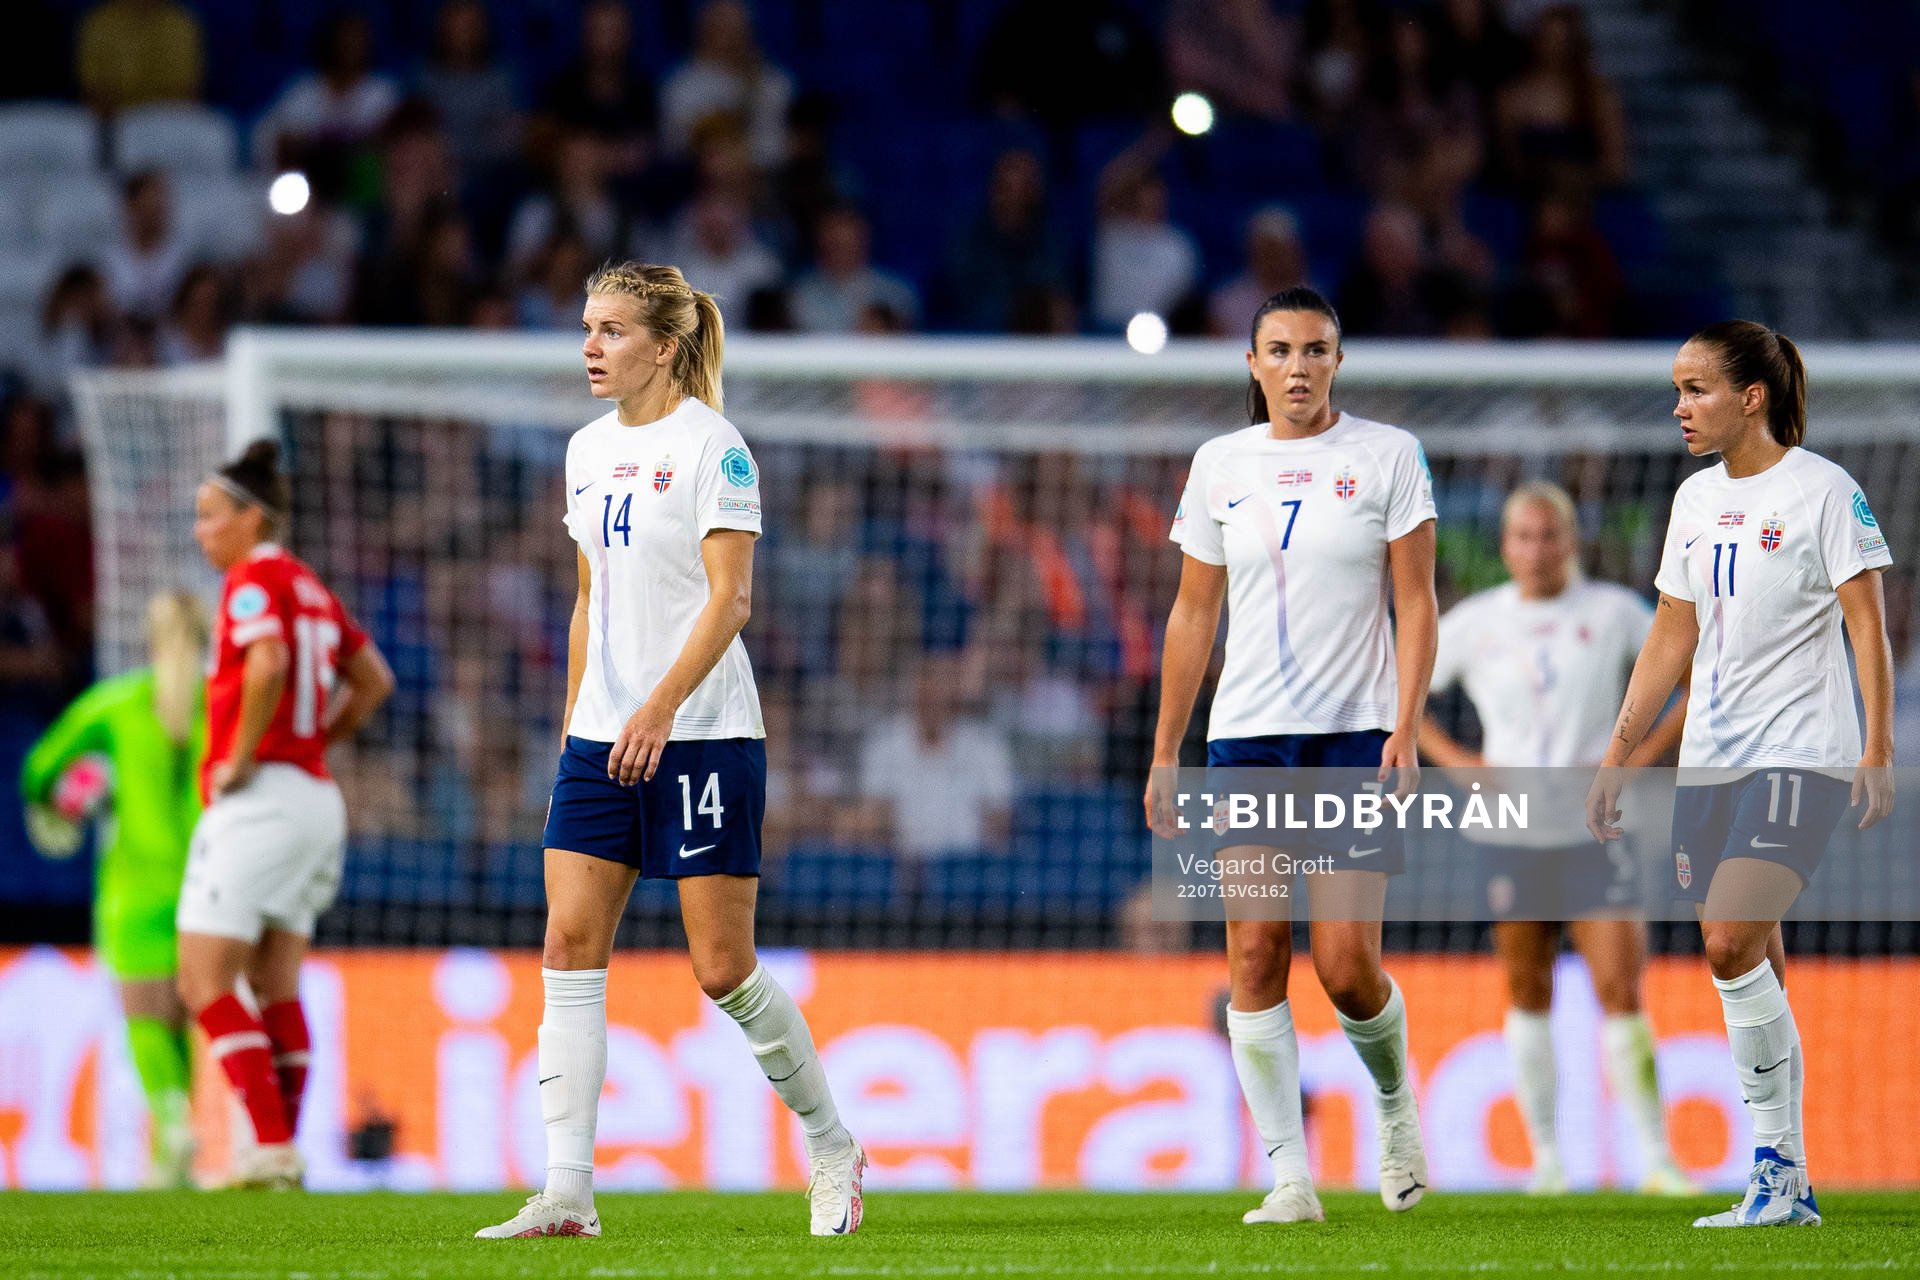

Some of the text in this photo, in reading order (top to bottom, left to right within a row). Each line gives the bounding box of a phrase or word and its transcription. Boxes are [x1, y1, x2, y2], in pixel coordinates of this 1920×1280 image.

[602, 493, 632, 547] 14
[1281, 500, 1302, 550] 7
[1713, 543, 1738, 597] 11
[678, 772, 724, 830] 14
[1767, 772, 1802, 827] 11
